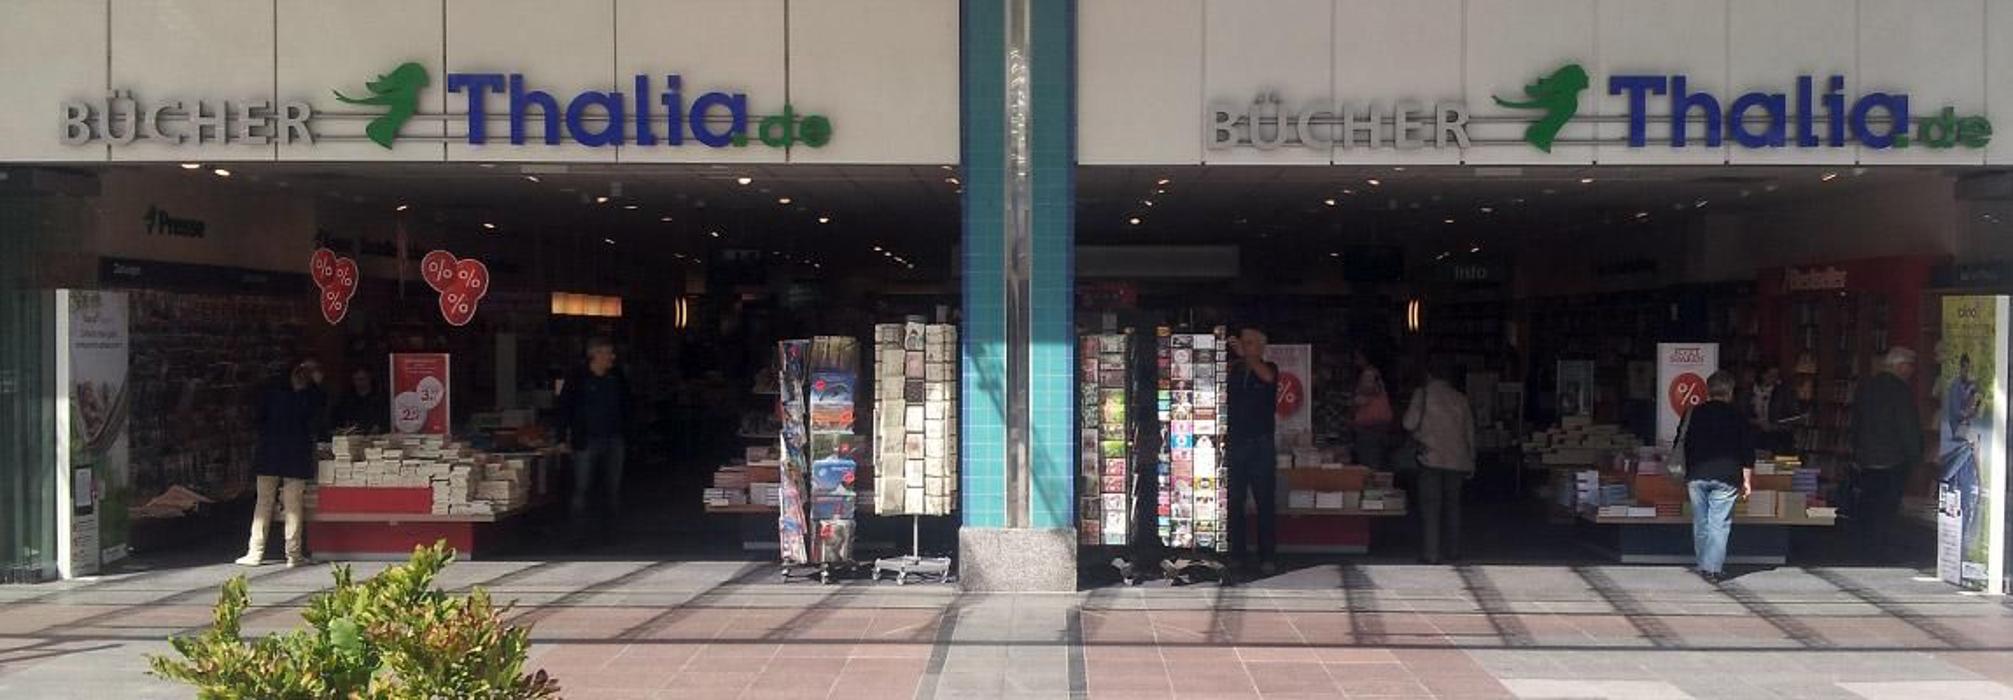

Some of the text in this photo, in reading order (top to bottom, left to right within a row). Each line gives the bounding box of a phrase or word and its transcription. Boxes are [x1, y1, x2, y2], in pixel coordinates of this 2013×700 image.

[59, 89, 315, 145] BÜCHER
[1207, 93, 1471, 150] BÜCHER
[1455, 263, 1488, 281] Info
